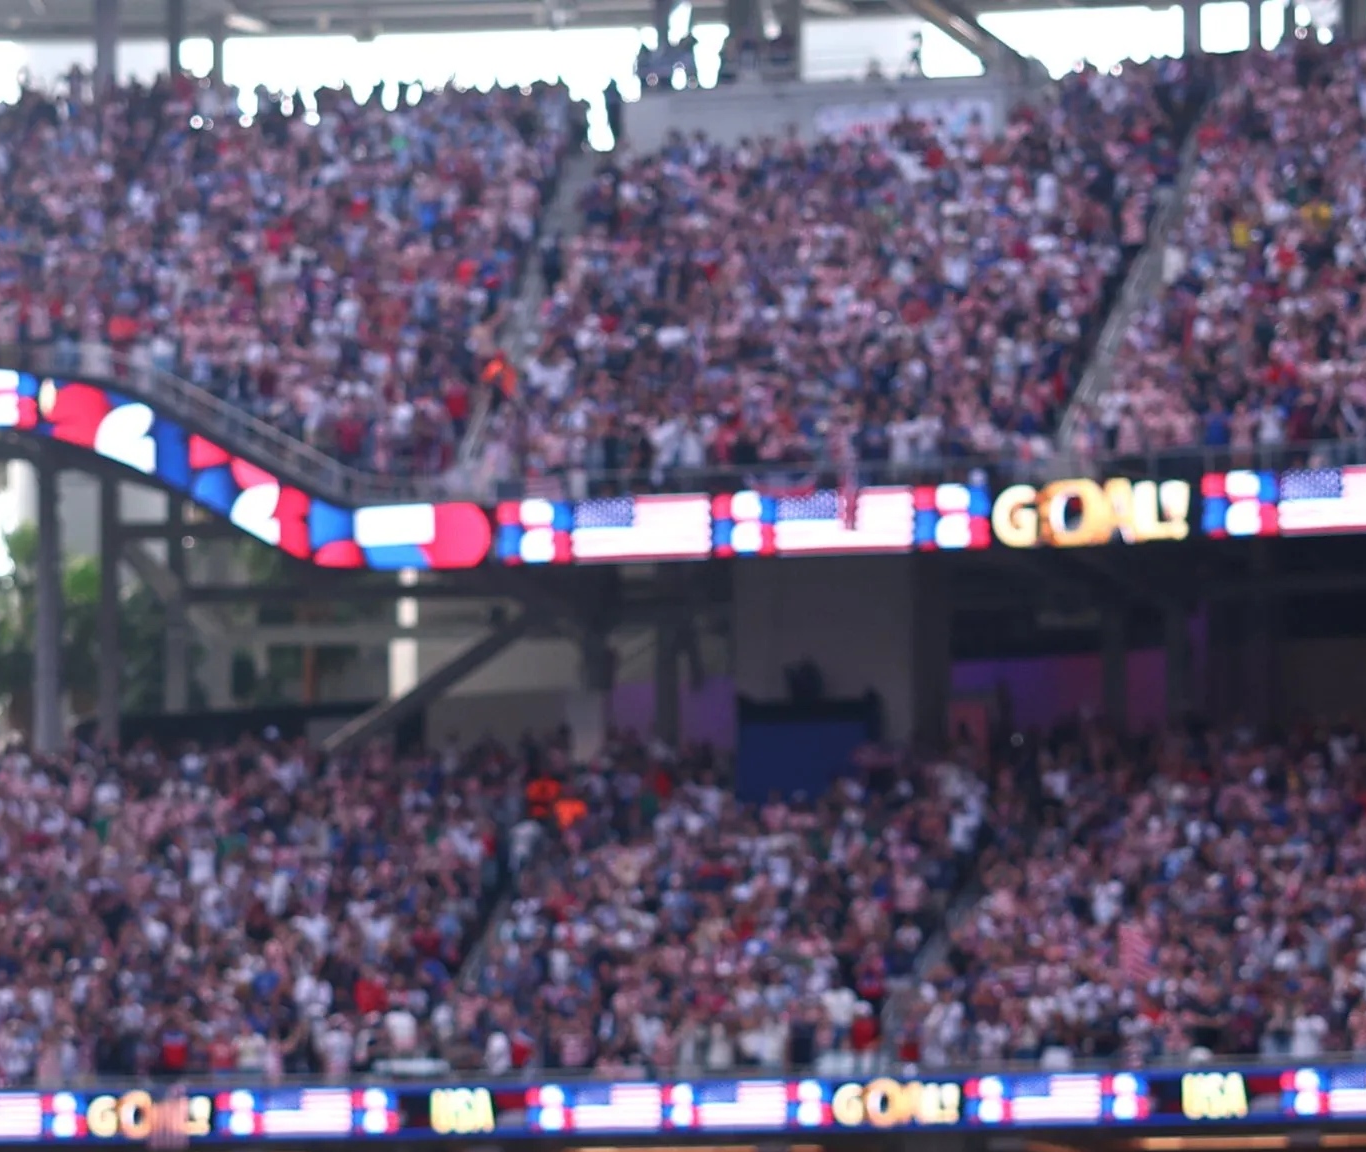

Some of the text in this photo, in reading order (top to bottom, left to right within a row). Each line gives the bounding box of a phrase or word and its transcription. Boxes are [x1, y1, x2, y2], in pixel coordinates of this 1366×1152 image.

[992, 476, 1191, 549] GOAL!
[832, 1077, 961, 1127] GOAL!
[1181, 1072, 1249, 1120] USA
